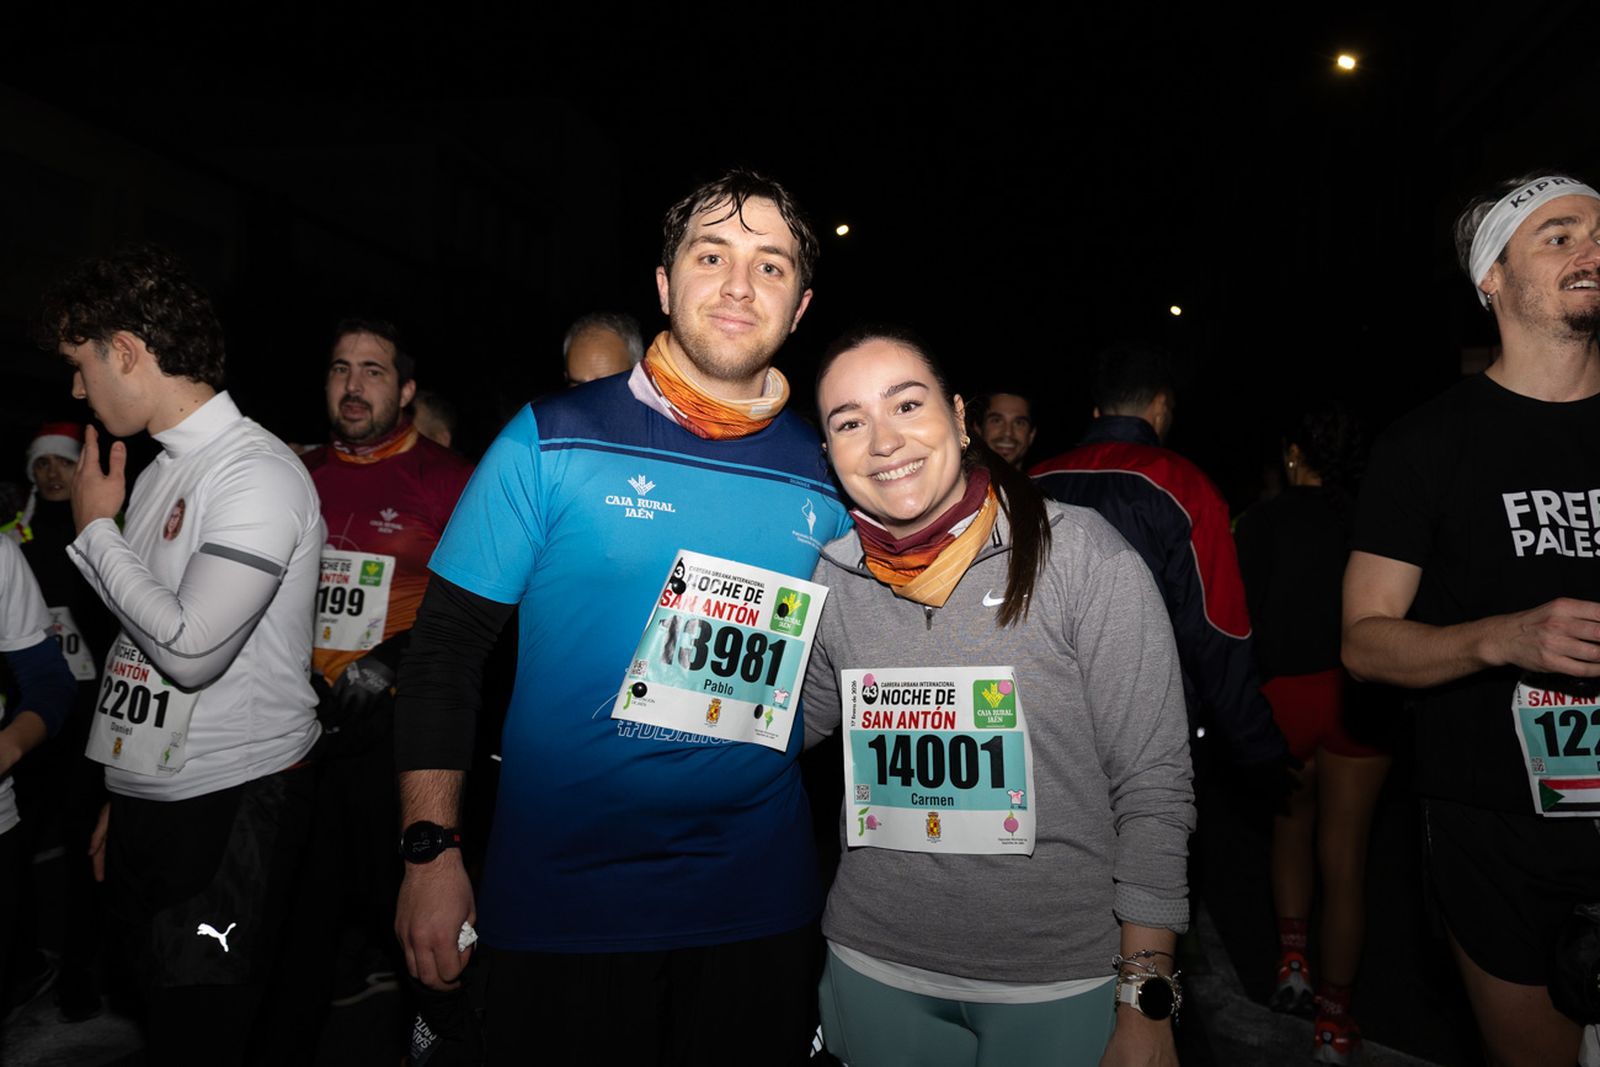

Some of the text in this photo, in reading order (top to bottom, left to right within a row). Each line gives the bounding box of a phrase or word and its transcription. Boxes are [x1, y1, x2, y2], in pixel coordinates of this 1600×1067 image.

[605, 495, 676, 513] CAJA RURAL
[624, 506, 654, 521] JAÉN
[743, 586, 764, 605] DE
[702, 597, 760, 627] ANTÓN
[657, 614, 788, 688] 13981
[703, 678, 734, 696] Pablo
[862, 685, 878, 698] 43
[98, 675, 171, 729] 2201
[880, 688, 956, 705] NOCHE DE
[1528, 689, 1566, 707] SAN
[861, 705, 956, 730] SAN ANTÓN
[977, 709, 1013, 717] CAJA RURAL
[110, 721, 133, 736] Daniel
[867, 733, 1006, 790] 14001
[911, 792, 955, 807] Carmen
